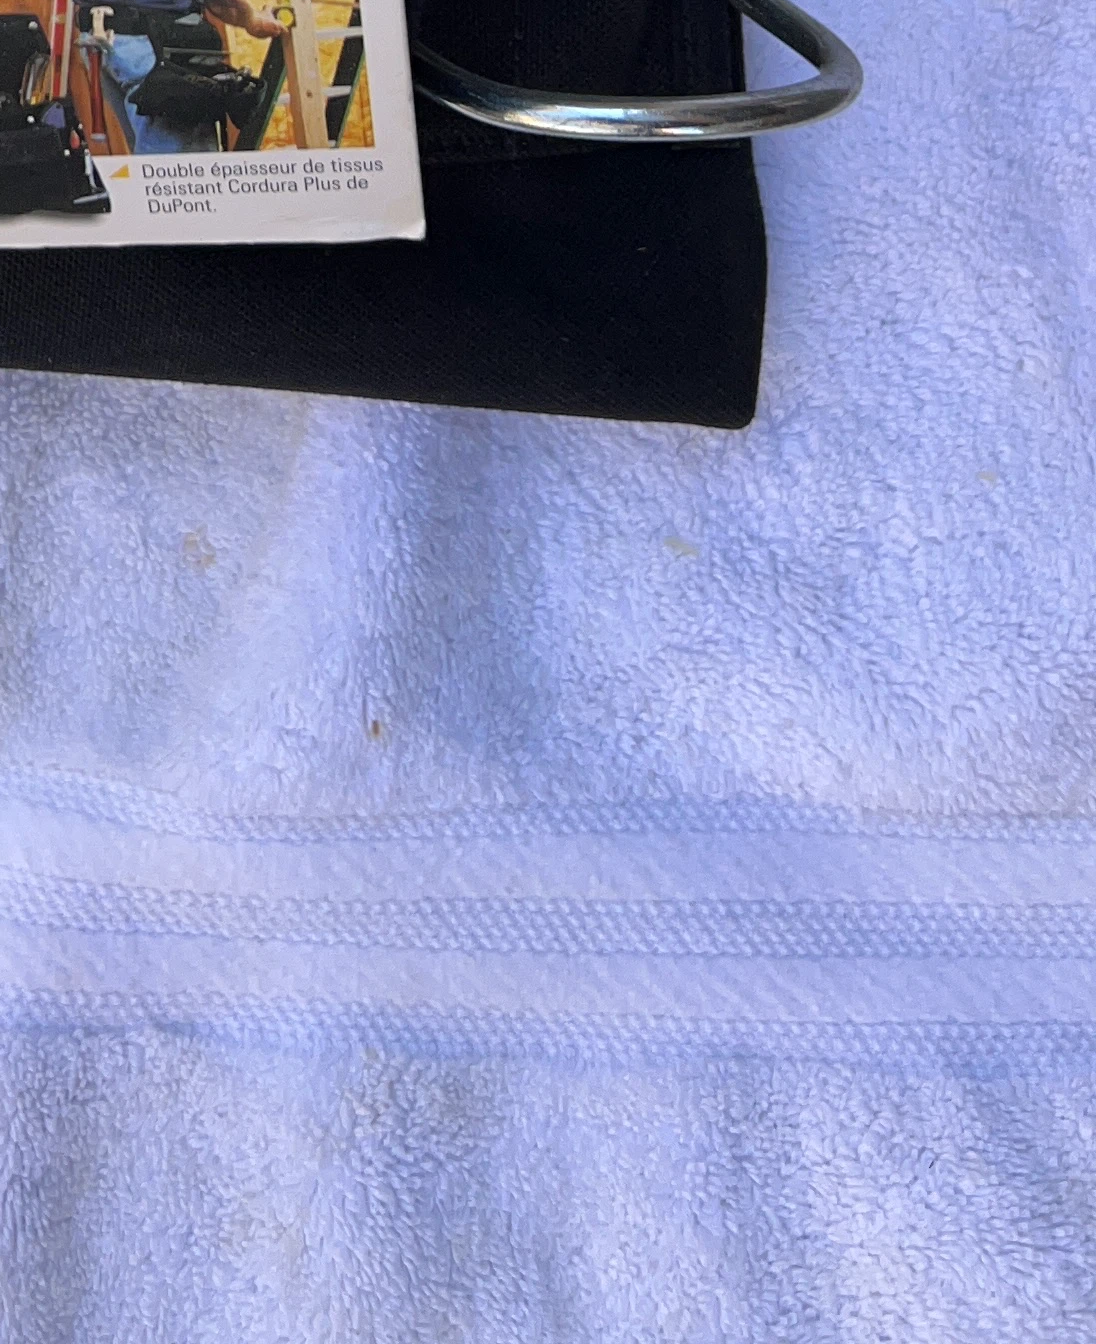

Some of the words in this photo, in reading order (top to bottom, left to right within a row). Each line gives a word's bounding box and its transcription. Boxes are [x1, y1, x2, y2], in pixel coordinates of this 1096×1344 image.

[142, 162, 204, 179] Double
[211, 161, 297, 179] épaisseur
[303, 158, 325, 174] de
[331, 158, 384, 173] tissus
[145, 180, 222, 196] résistant
[228, 178, 298, 194] Cordura
[304, 176, 341, 191] Plus
[347, 175, 369, 190] de
[148, 198, 217, 214] DuPont.
